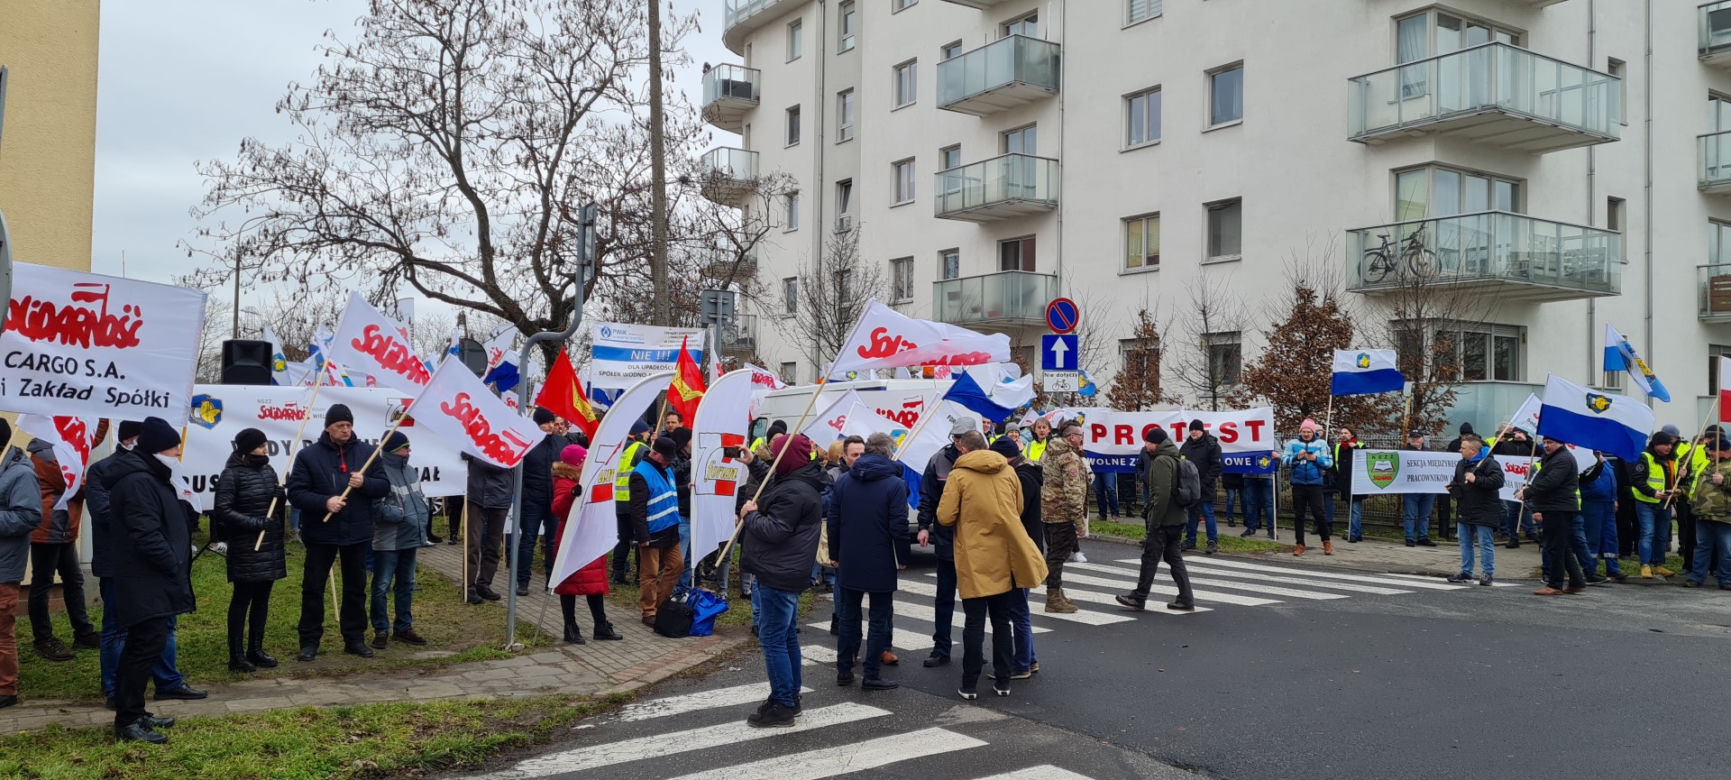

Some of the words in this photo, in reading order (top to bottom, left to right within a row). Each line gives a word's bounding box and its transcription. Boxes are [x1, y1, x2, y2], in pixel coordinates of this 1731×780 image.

[4, 283, 143, 349] OLIDARNOŚĆ
[4, 351, 78, 375] CARGO
[85, 359, 125, 380] S.A.
[631, 350, 652, 360] NIE
[19, 379, 93, 400] Zakład
[105, 387, 170, 408] Spółki
